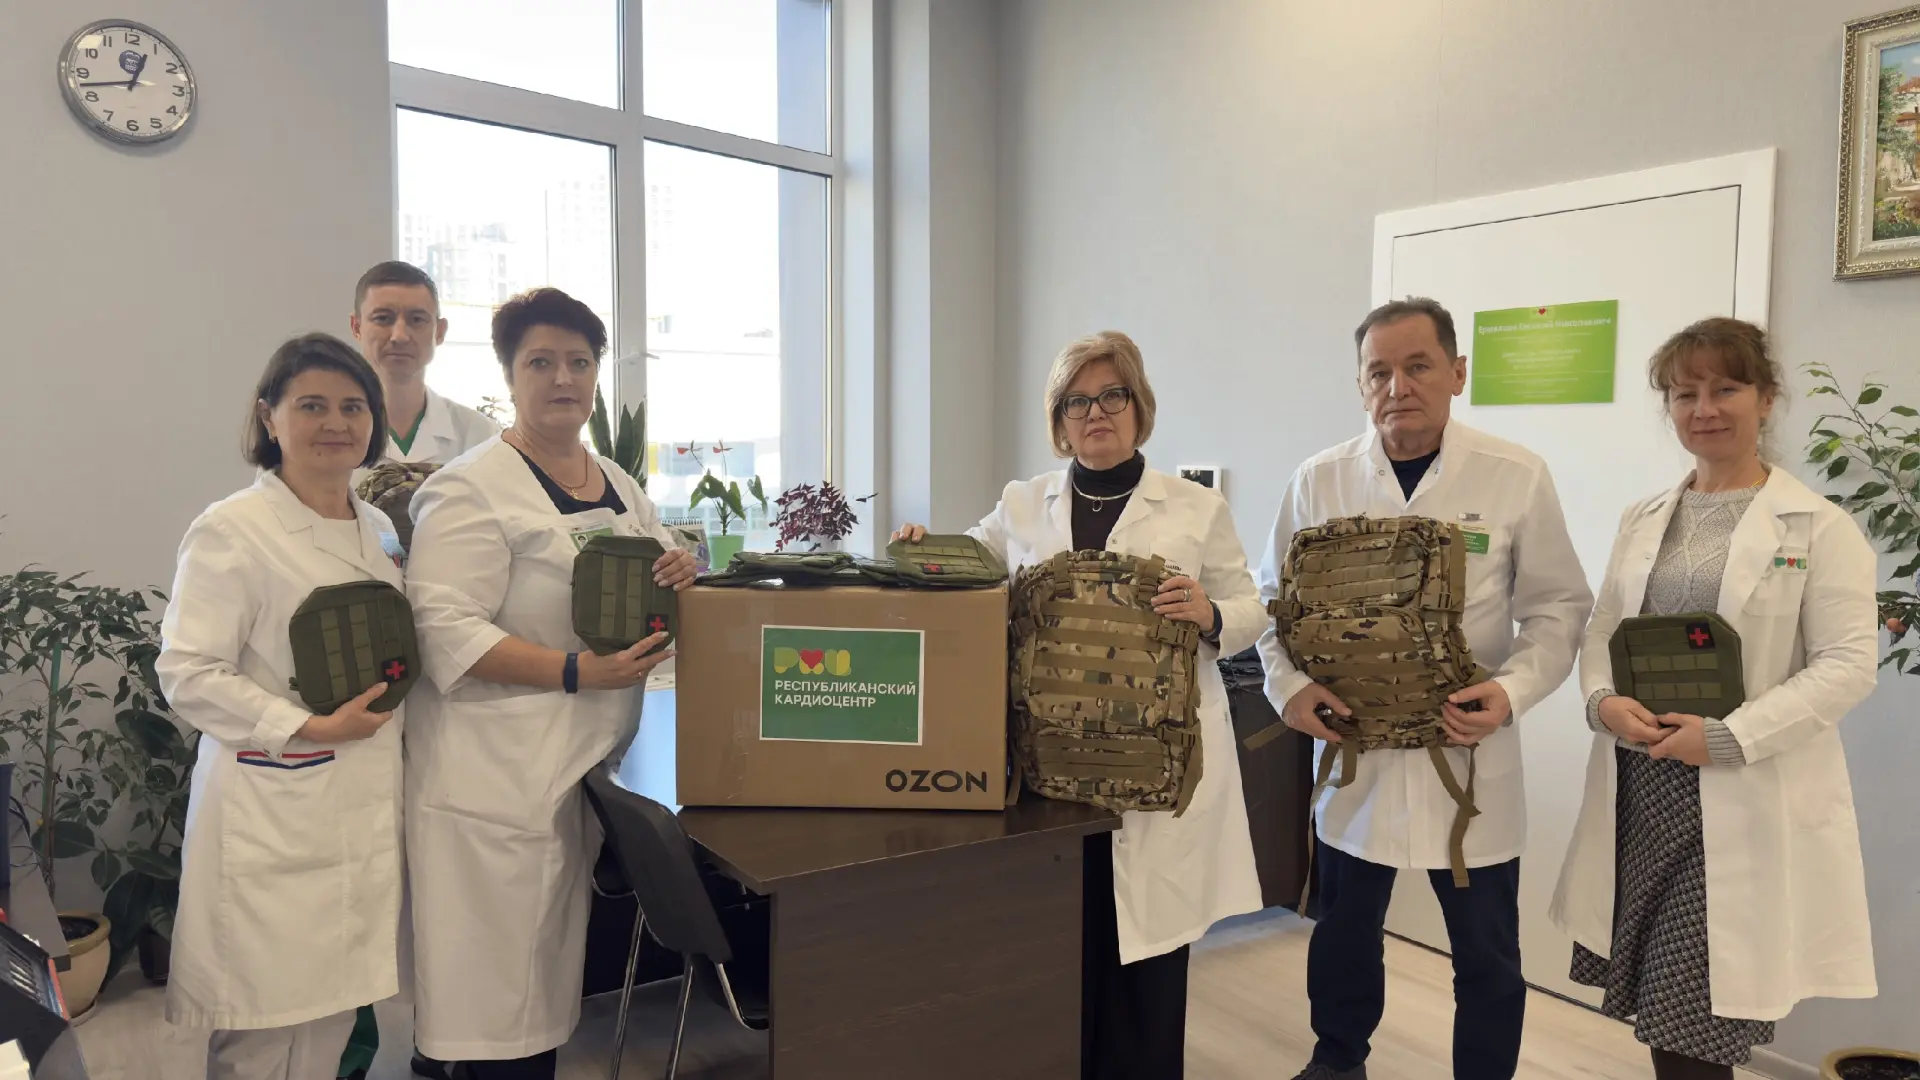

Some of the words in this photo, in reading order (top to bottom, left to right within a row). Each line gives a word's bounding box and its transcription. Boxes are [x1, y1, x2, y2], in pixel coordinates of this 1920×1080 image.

[103, 35, 112, 47] 11
[124, 32, 140, 46] 12
[85, 48, 98, 59] 10
[154, 43, 158, 55] 1
[76, 67, 90, 79] 9
[165, 62, 178, 75] 2
[85, 91, 99, 103] 8
[172, 85, 185, 97] 3
[103, 109, 114, 122] 7
[166, 105, 178, 116] 4
[126, 119, 140, 132] 6
[150, 117, 163, 129] 5
[775, 680, 916, 695] РЕСПУБЛИКАНСКИЙ
[774, 694, 876, 708] КАРДИОЦЕНТР
[885, 769, 987, 793] OZON
